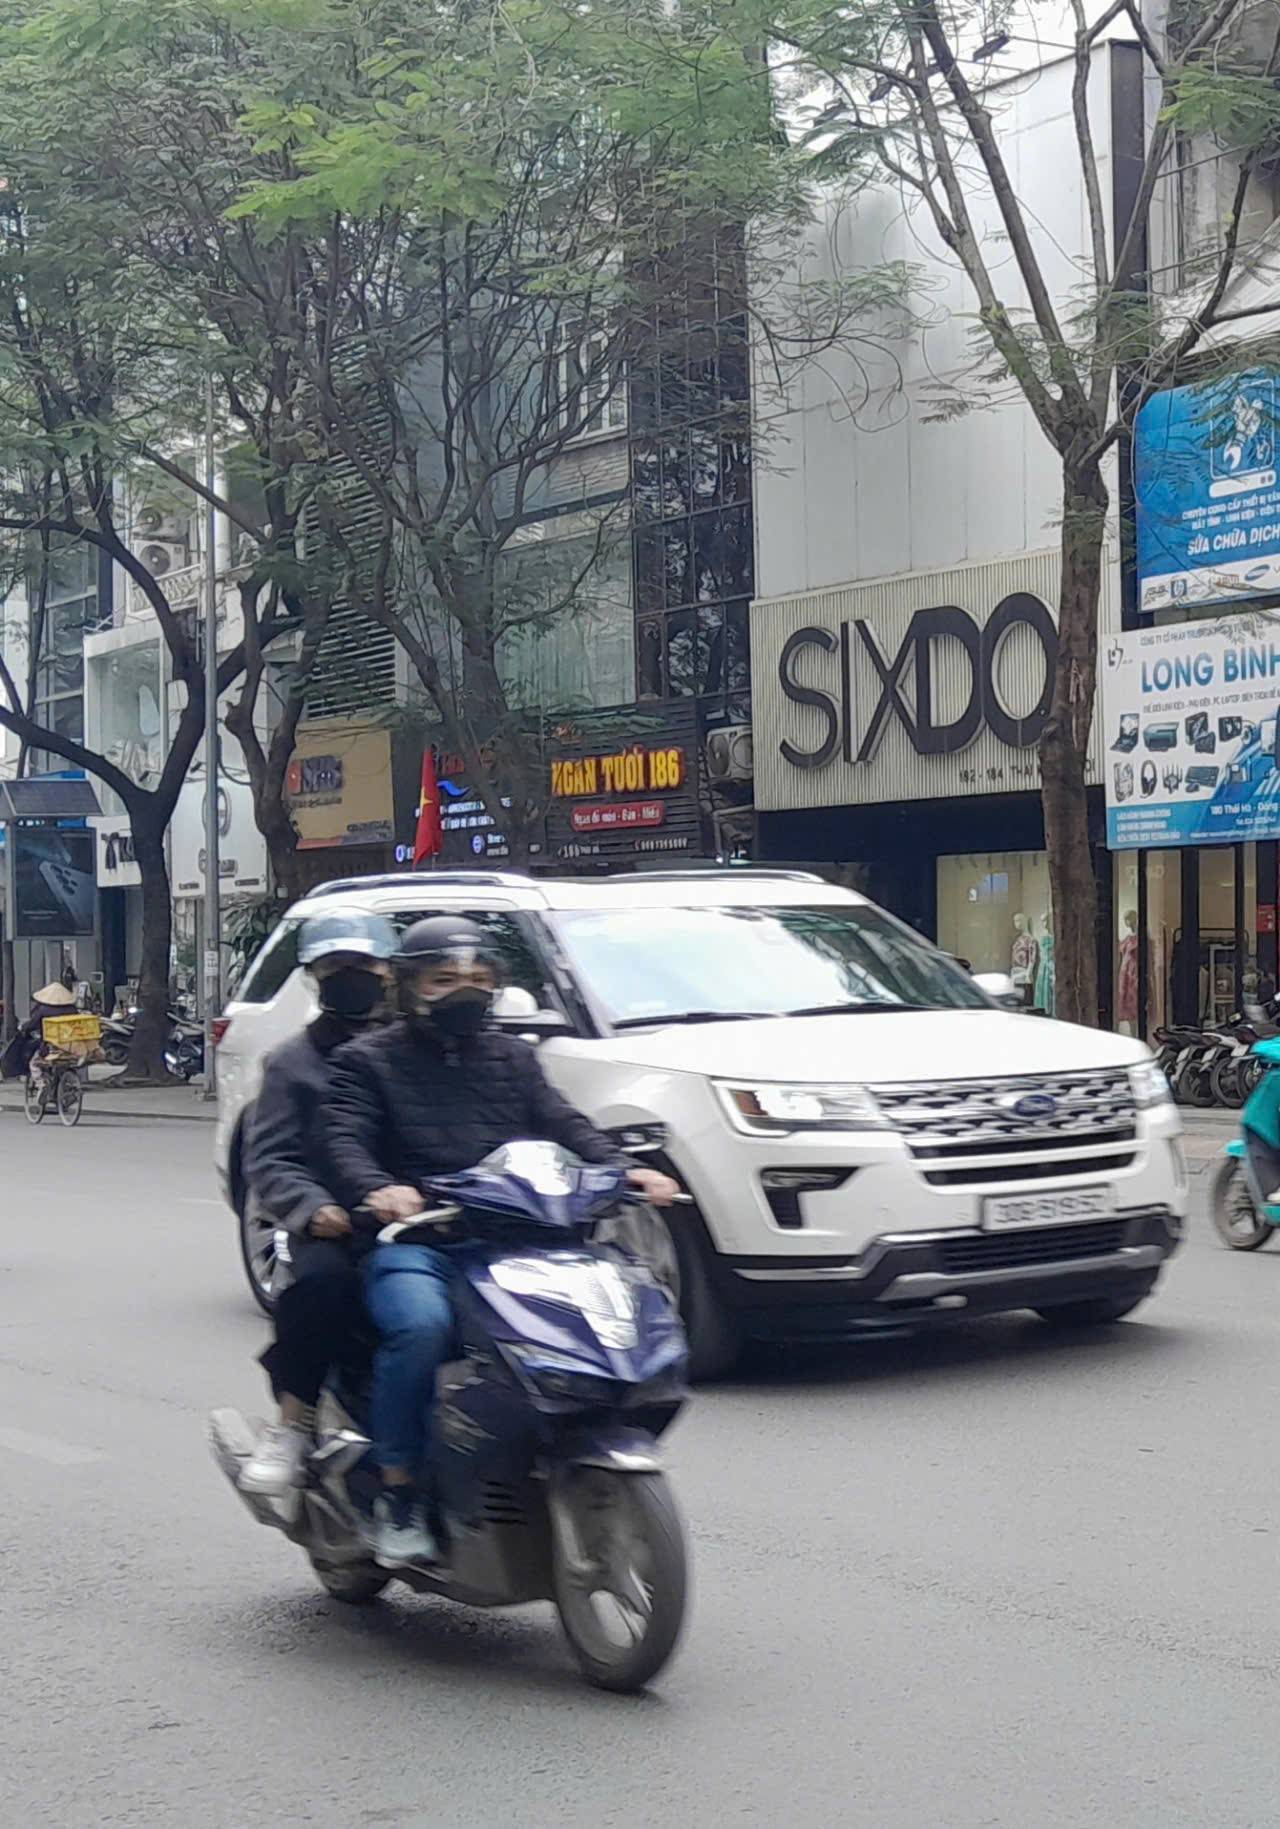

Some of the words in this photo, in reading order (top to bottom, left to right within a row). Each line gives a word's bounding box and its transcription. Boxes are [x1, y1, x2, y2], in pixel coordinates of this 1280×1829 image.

[1187, 533, 1210, 555] SỬA
[1213, 528, 1247, 551] CHỮA
[1250, 523, 1280, 547] DỊCH
[779, 591, 1060, 770] SIXDO
[1141, 652, 1214, 693] LONG
[649, 749, 680, 788] 186
